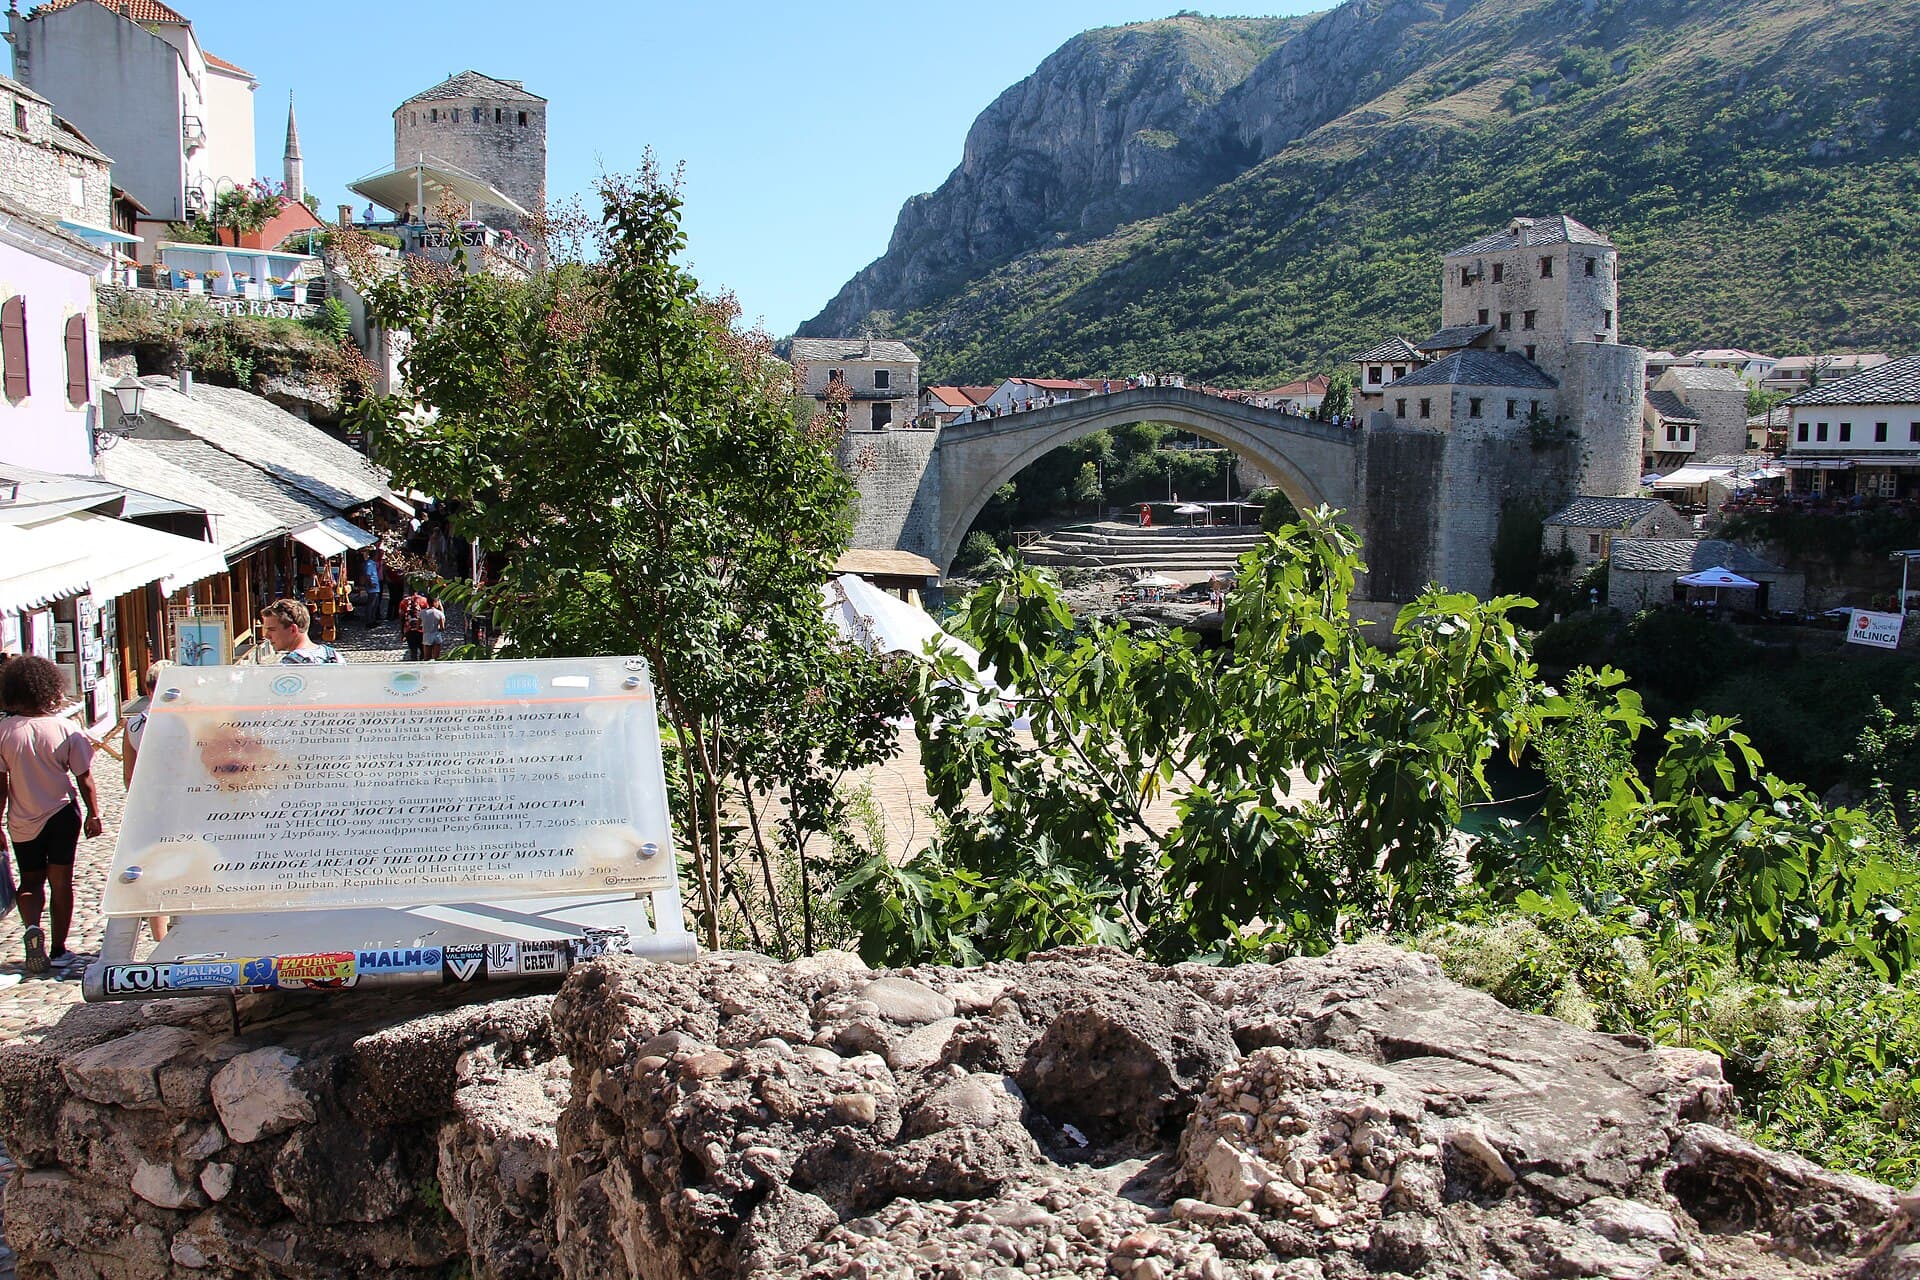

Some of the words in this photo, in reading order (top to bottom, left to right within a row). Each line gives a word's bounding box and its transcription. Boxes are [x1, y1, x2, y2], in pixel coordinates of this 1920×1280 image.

[421, 232, 484, 246] TERSA
[220, 301, 303, 319] TERASA
[1854, 630, 1896, 643] MLINICA
[300, 719, 357, 727] STAROG
[360, 717, 408, 725] MOSTA
[467, 713, 513, 723] GRADA
[516, 712, 580, 720] MOSTARA
[295, 762, 351, 770] STAROG
[355, 759, 404, 769] MOSTA
[407, 758, 462, 767] STAROG
[467, 757, 514, 765] GRADA
[518, 754, 583, 763] MOSTARA
[207, 811, 287, 821] ПОДРУЧЈЕ
[292, 809, 350, 818] СТАРОГ
[354, 806, 405, 816] МОСТА
[409, 805, 463, 813] СТАРОГ
[468, 803, 514, 812] ГРАДА
[518, 800, 584, 809] МОСТАРА
[256, 851, 279, 859] The
[283, 849, 321, 858] World
[325, 847, 380, 857] Heritage
[384, 845, 451, 853] Committee
[456, 843, 476, 851] has
[480, 840, 535, 849] inscribed
[214, 863, 245, 871] OLD
[250, 860, 308, 870] BRIDGE
[312, 859, 352, 867] AREA
[356, 857, 378, 865] OF
[384, 856, 415, 864] THE
[418, 854, 448, 863] OLD
[453, 852, 487, 861] CITY
[491, 851, 511, 859] OF
[515, 849, 575, 859] MOSTAR
[321, 867, 384, 877] UNESCO
[389, 866, 425, 874] World
[430, 864, 484, 873] Heritage
[489, 862, 511, 870] List
[184, 885, 211, 894] 29th
[216, 884, 266, 893] Session
[271, 882, 282, 890] in
[344, 877, 400, 887] Republic
[422, 874, 457, 884] South
[530, 870, 555, 879] 17th
[560, 868, 584, 878] July
[176, 963, 233, 977] MALMÖ
[524, 954, 555, 970] CREW
[280, 965, 338, 978] SYNDIKAT
